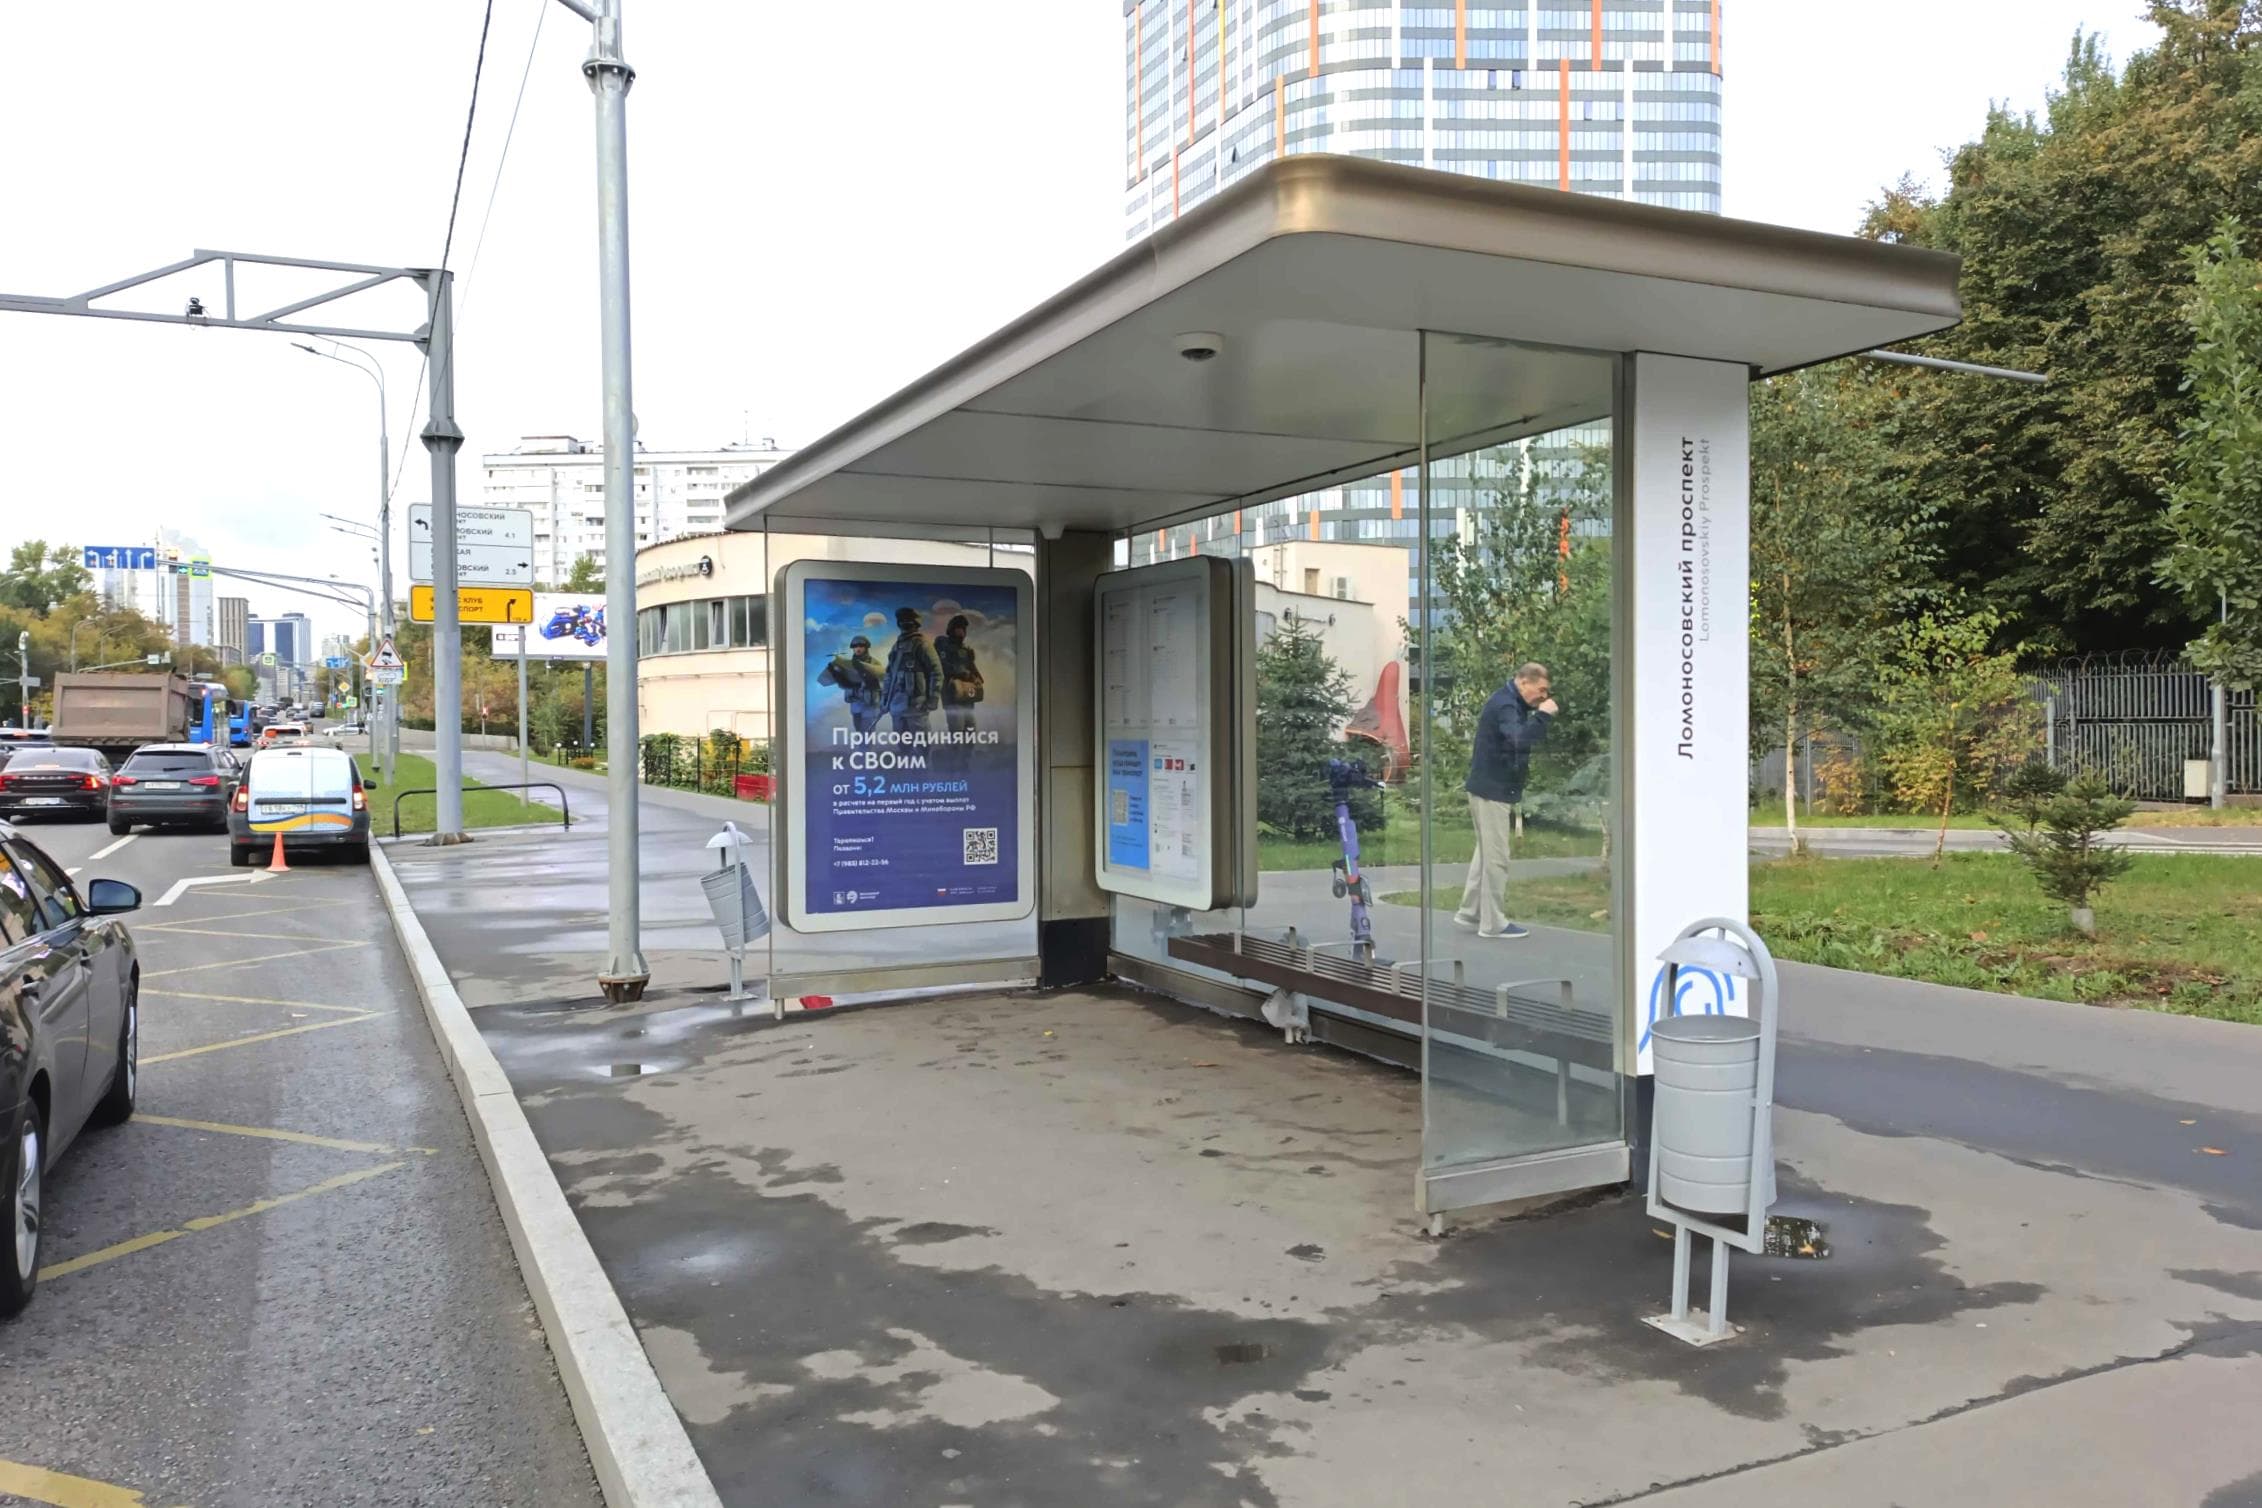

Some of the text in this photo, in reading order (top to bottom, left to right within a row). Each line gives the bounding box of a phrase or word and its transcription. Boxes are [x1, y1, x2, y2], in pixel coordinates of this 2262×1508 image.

[1699, 438, 1712, 642] Lomonosovskiy Prospekt
[1678, 437, 1697, 760] Ломоносовский проспект
[832, 727, 999, 749] Присоединяйся
[832, 751, 927, 770] к СВОим
[833, 776, 968, 797] от 5,2 МЛН РУБЛЕЙ
